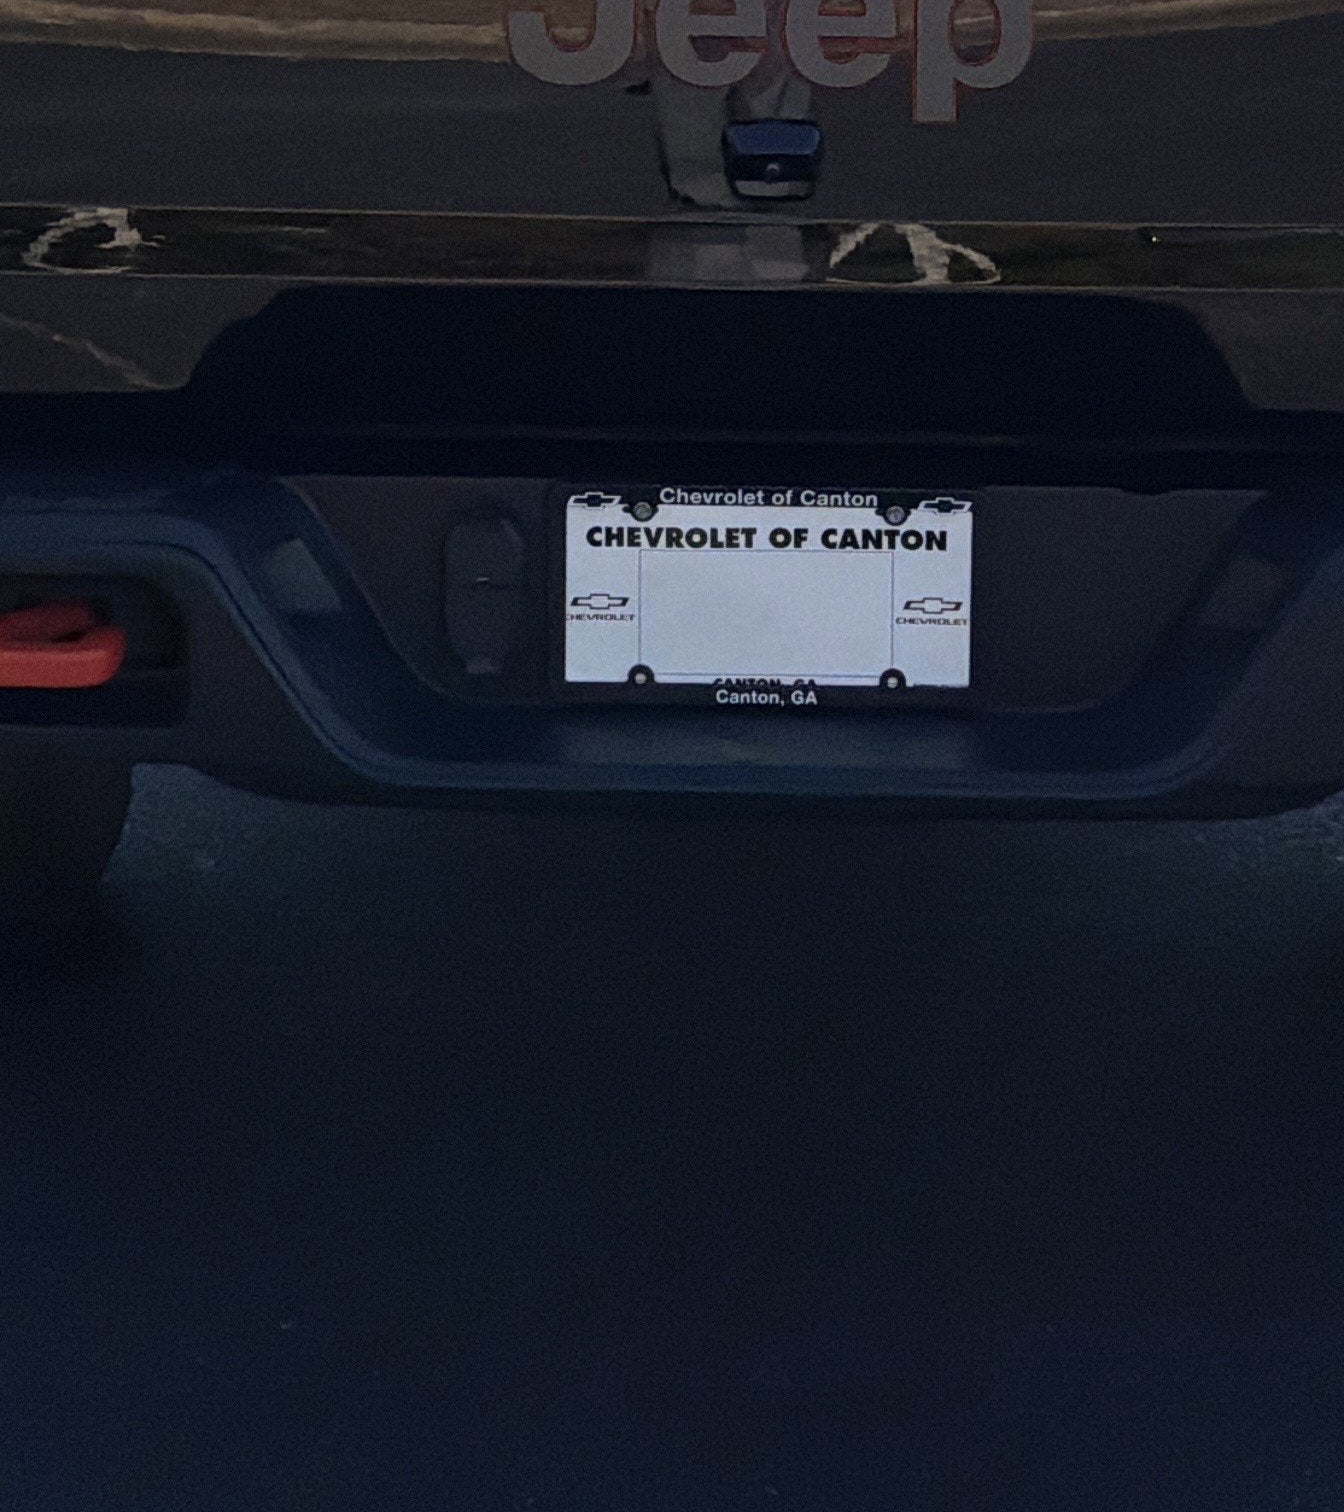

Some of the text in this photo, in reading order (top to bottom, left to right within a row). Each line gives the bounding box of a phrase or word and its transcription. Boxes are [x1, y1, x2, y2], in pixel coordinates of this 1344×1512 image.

[659, 487, 878, 507] Chevrolet of Canton
[586, 526, 948, 551] CHEVROLET OF CANTON
[896, 617, 967, 626] CHEVROLET
[716, 689, 818, 706] Canton, GA
